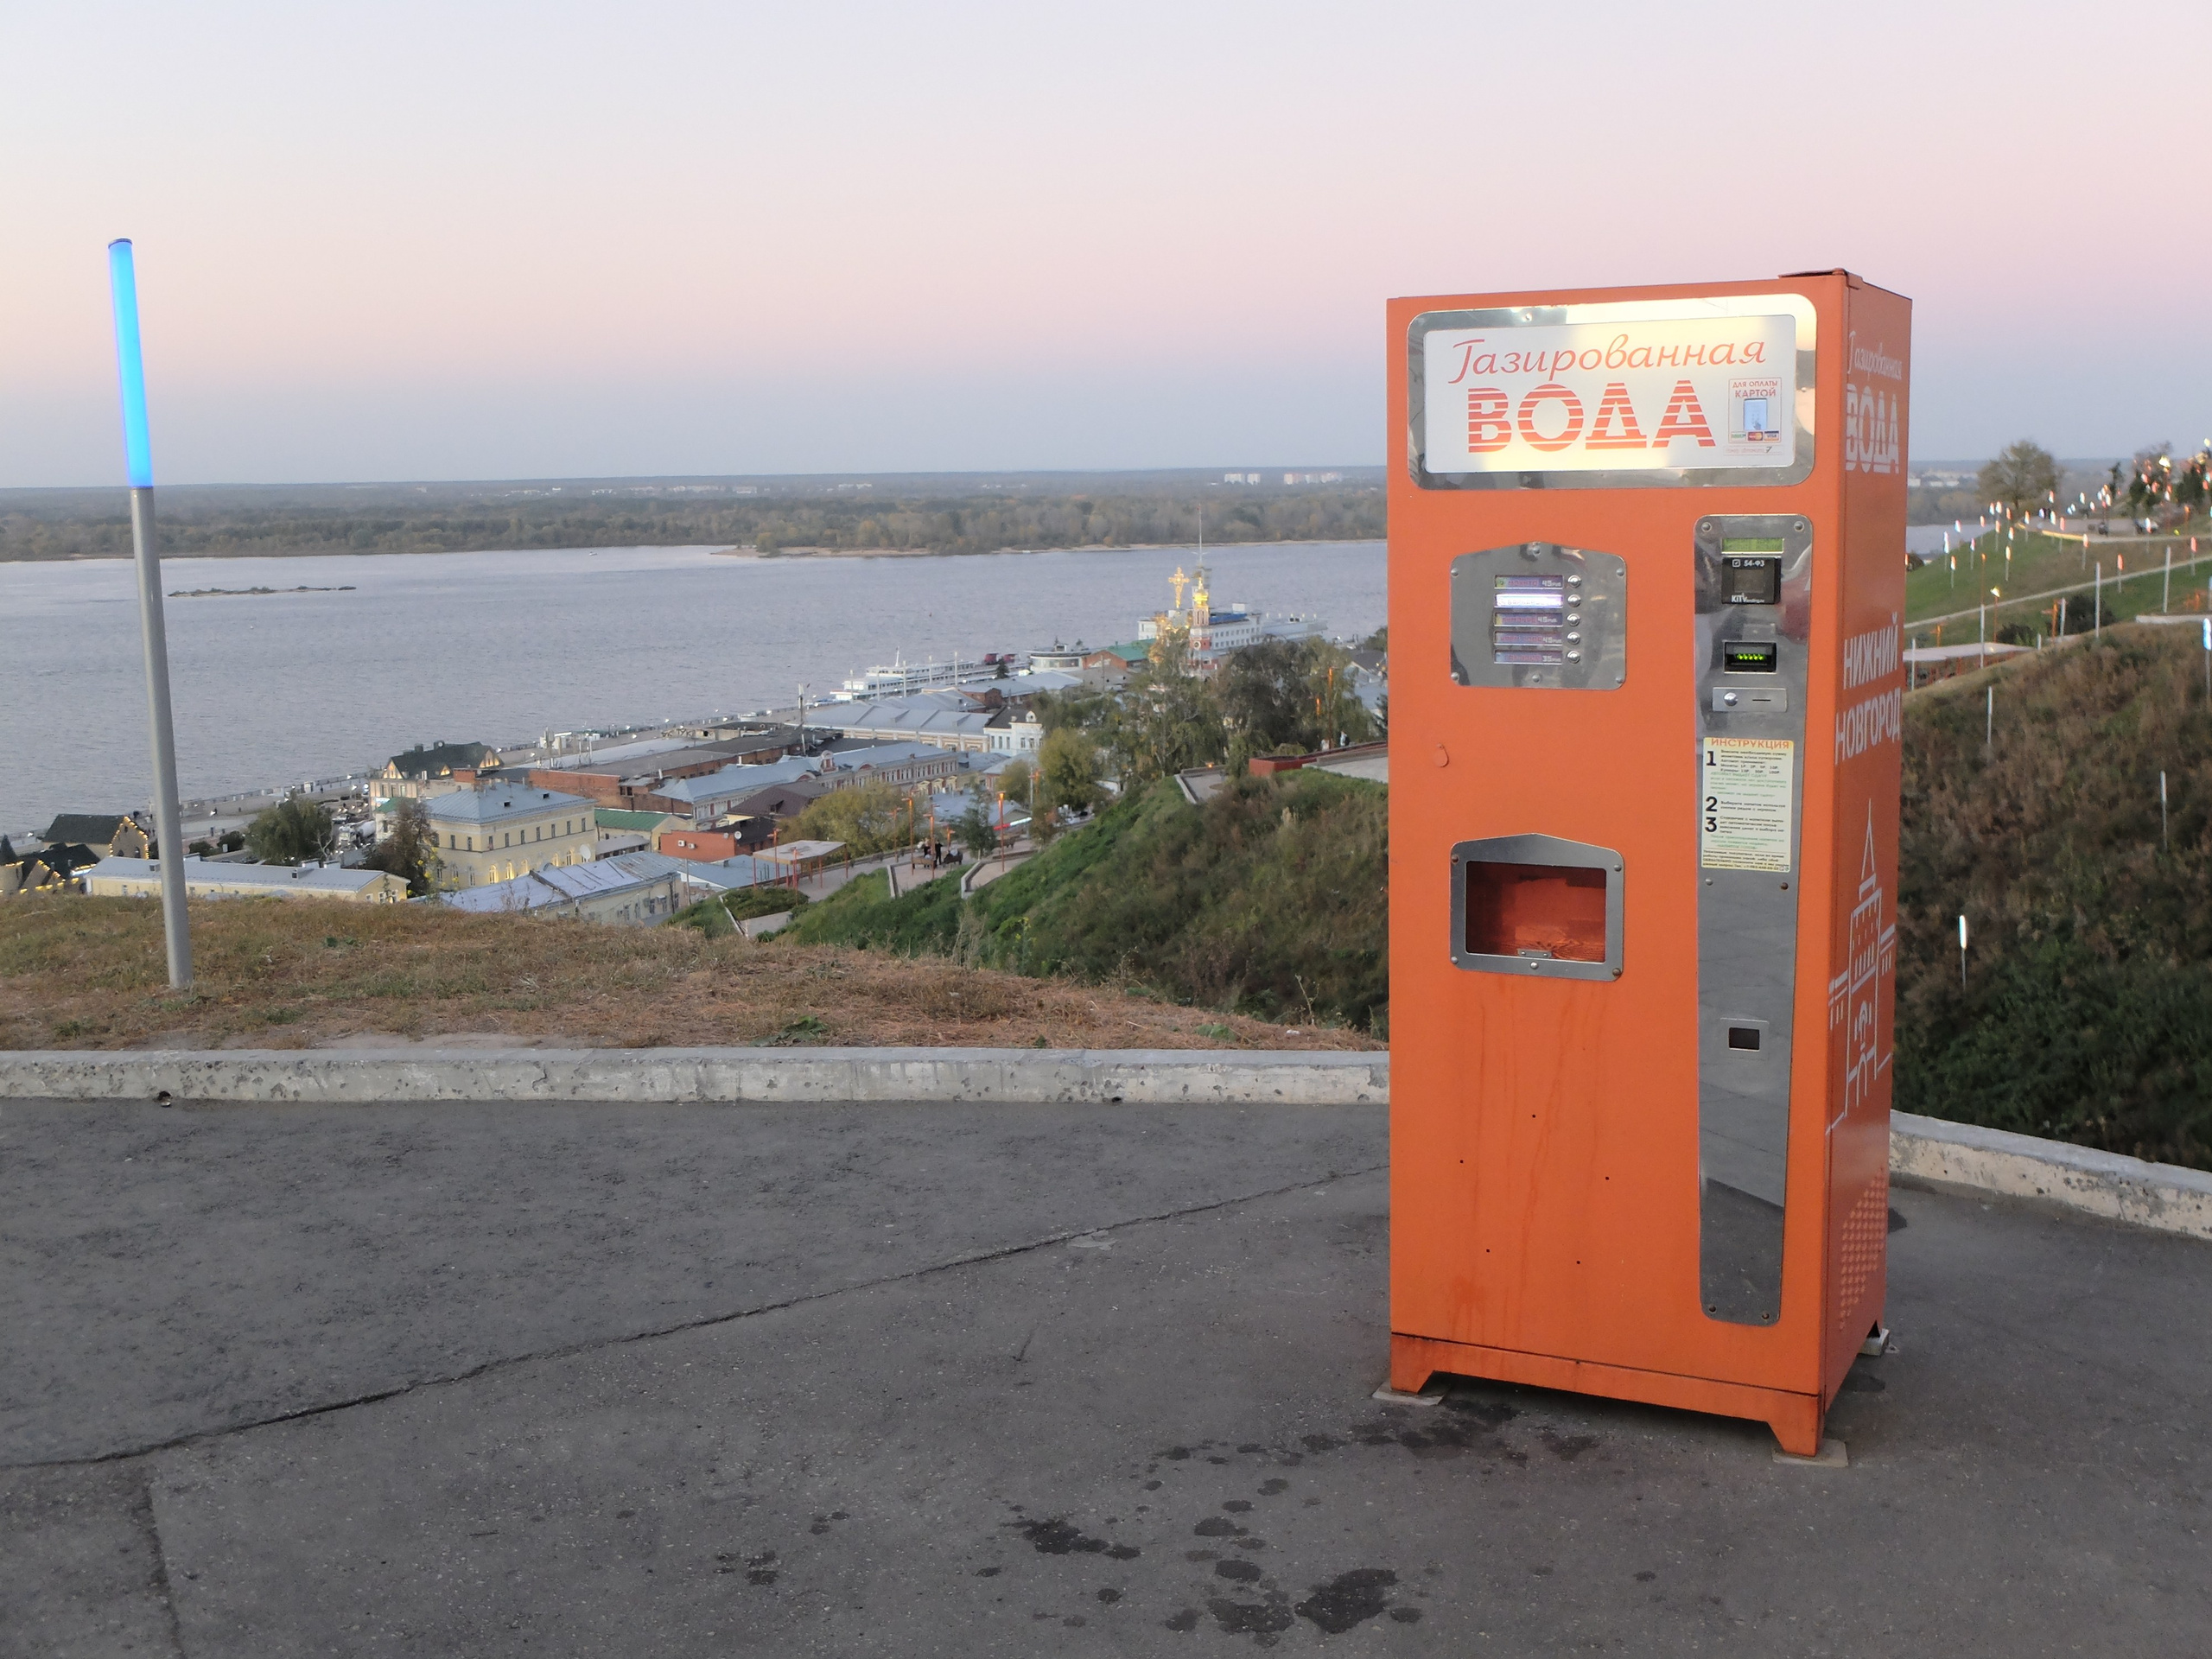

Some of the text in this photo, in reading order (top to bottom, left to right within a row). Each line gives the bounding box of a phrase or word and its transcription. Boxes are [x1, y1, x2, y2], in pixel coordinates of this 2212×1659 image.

[1448, 334, 1766, 384] Газированная
[1735, 387, 1777, 397] КАРТОЙ
[1468, 379, 1716, 453] ВОДА
[1846, 383, 1899, 474] ВОДА
[1843, 612, 1898, 690] НИЖНИЙ
[1834, 687, 1901, 766] НОВГОРОД
[1706, 751, 1716, 766] 1
[1711, 738, 1789, 750] ИНСТРУКЦИЯ
[1706, 796, 1717, 812] 2
[1705, 817, 1717, 833] 3
